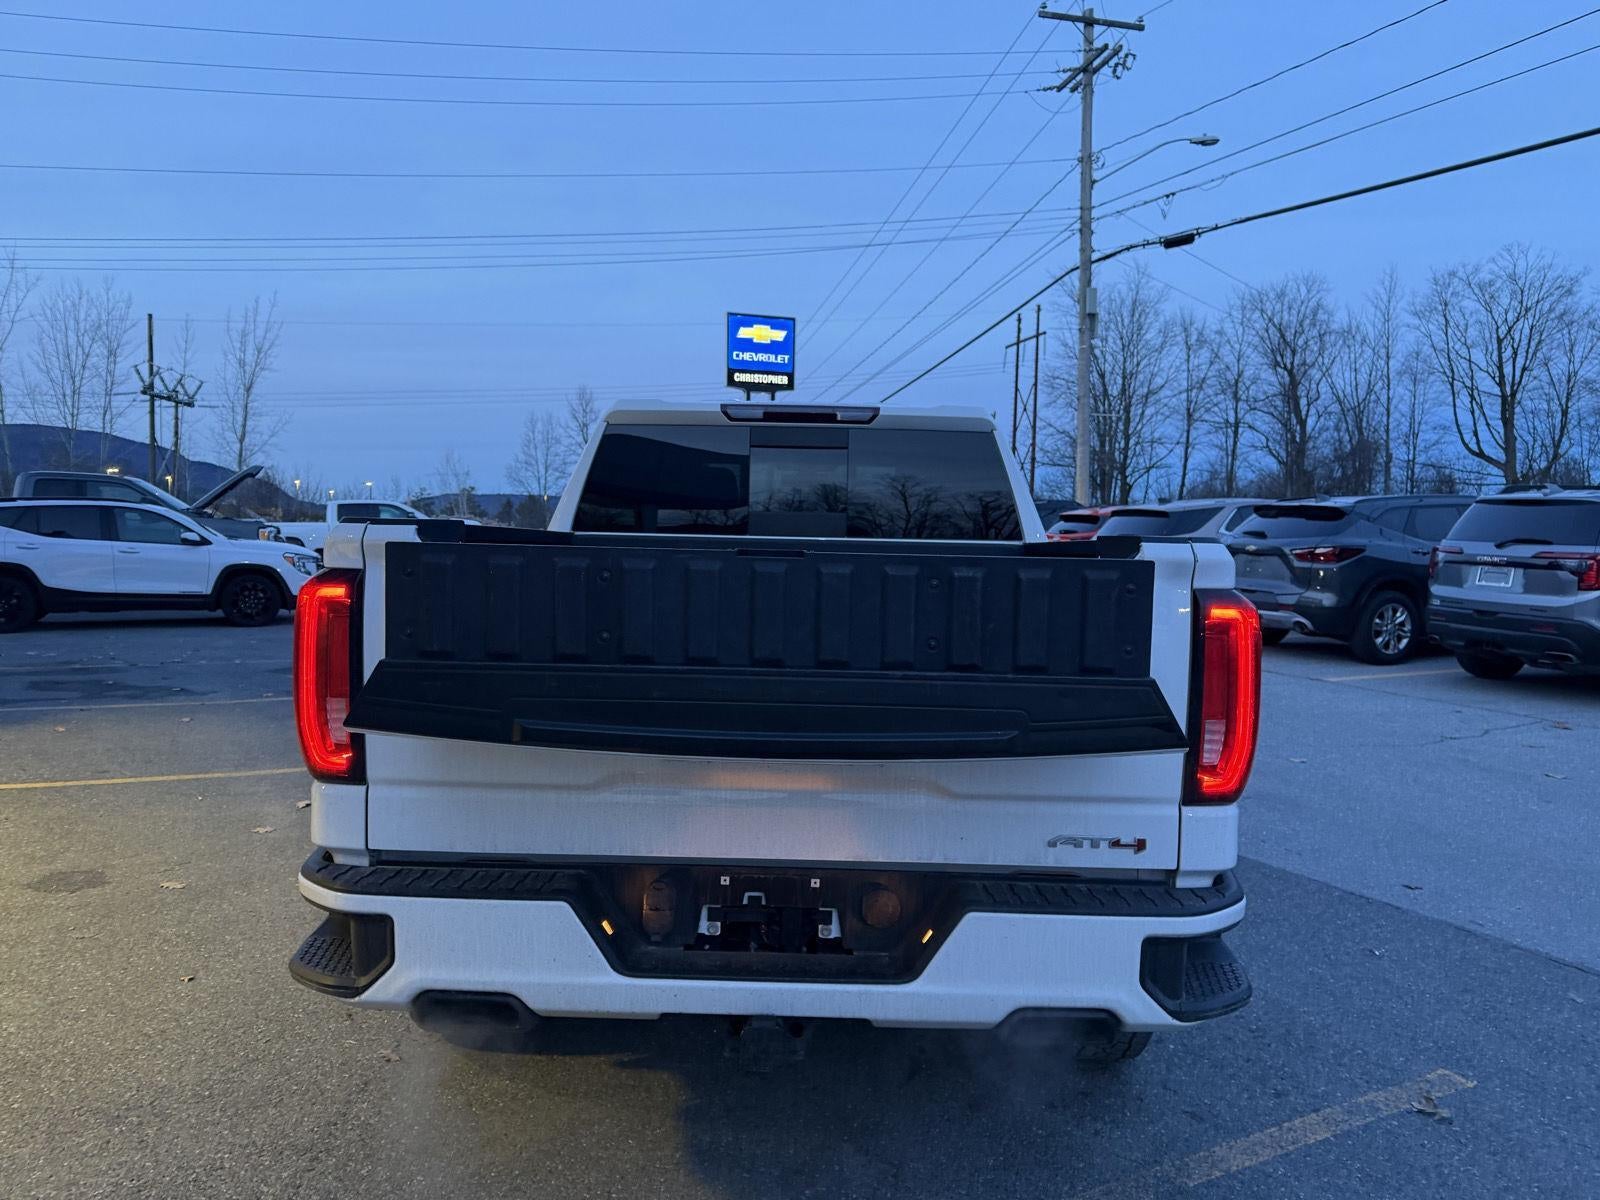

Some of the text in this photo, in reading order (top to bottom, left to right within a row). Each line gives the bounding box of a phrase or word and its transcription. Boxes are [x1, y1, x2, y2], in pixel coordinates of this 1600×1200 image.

[732, 351, 790, 364] CHEVROLET
[733, 372, 789, 385] CHRISTOPHER
[1047, 835, 1147, 855] AT4
